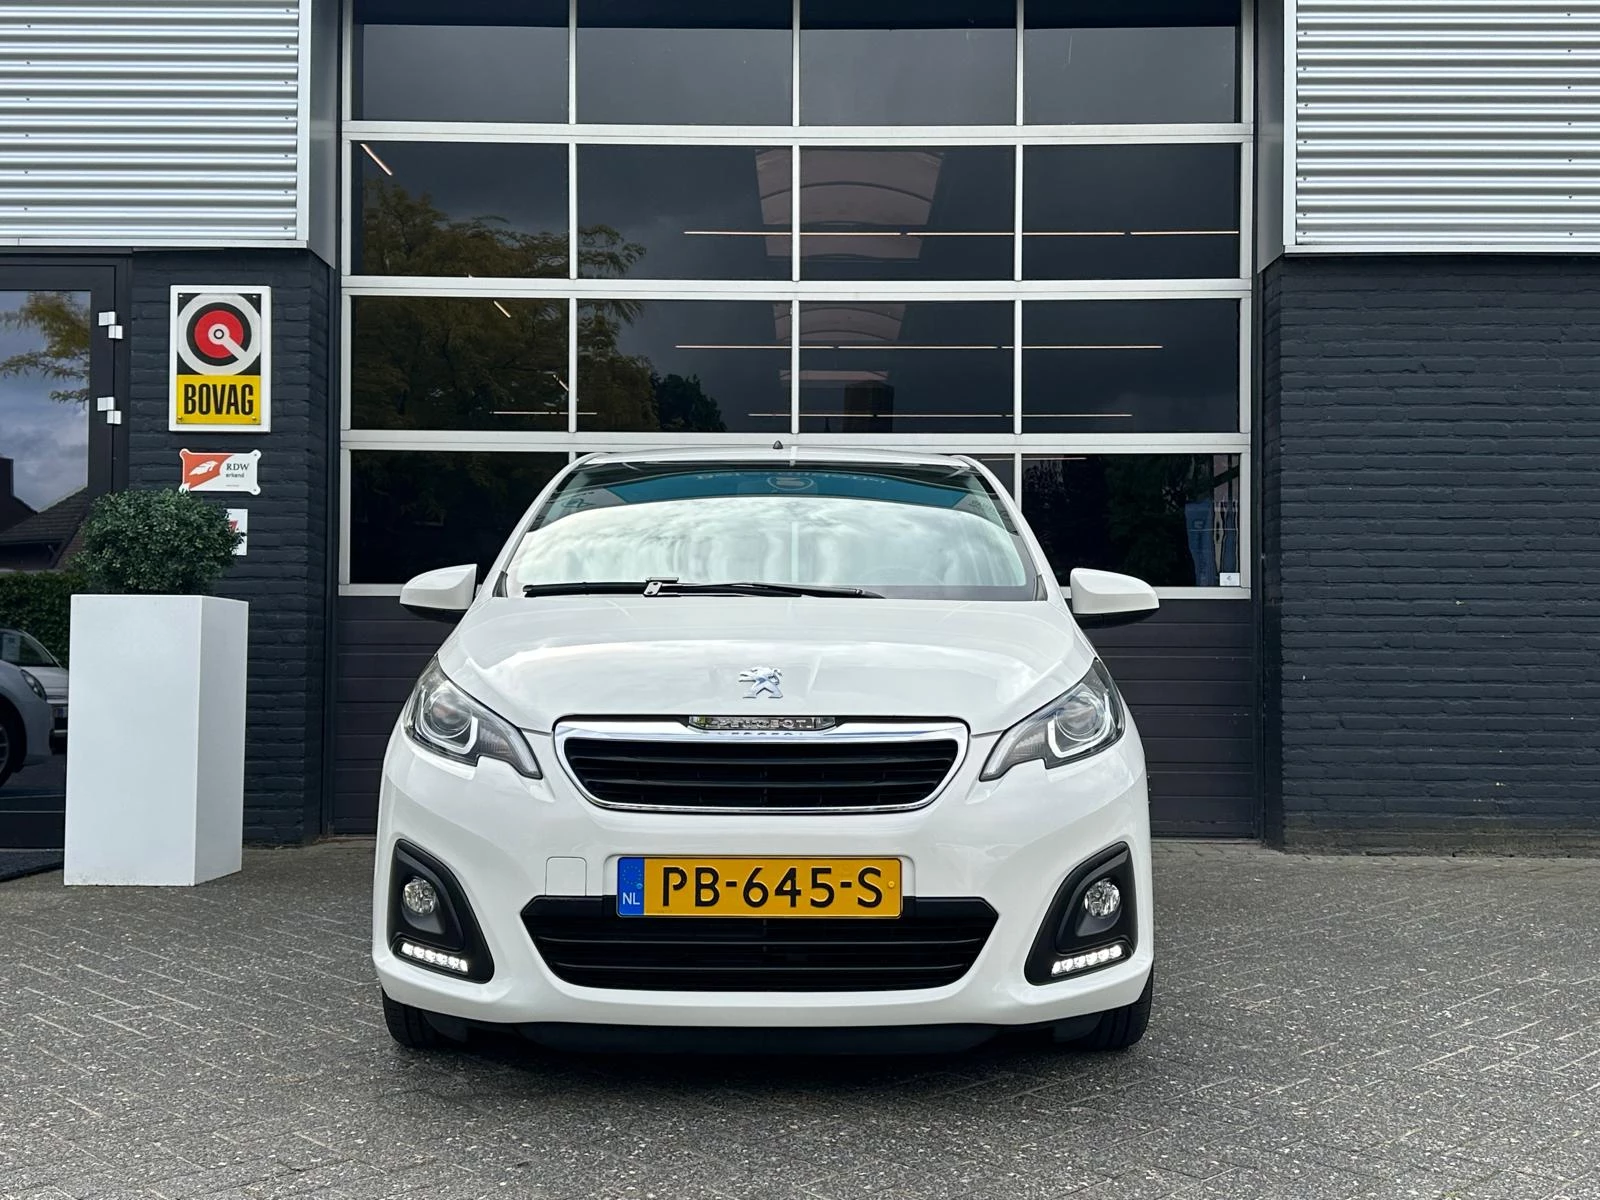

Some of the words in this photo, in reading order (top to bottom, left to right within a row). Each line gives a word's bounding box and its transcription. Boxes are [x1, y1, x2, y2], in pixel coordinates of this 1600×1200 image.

[183, 383, 254, 416] BOVAG
[225, 462, 250, 471] RDW
[622, 891, 641, 905] NL
[661, 866, 883, 909] PB-645-S
